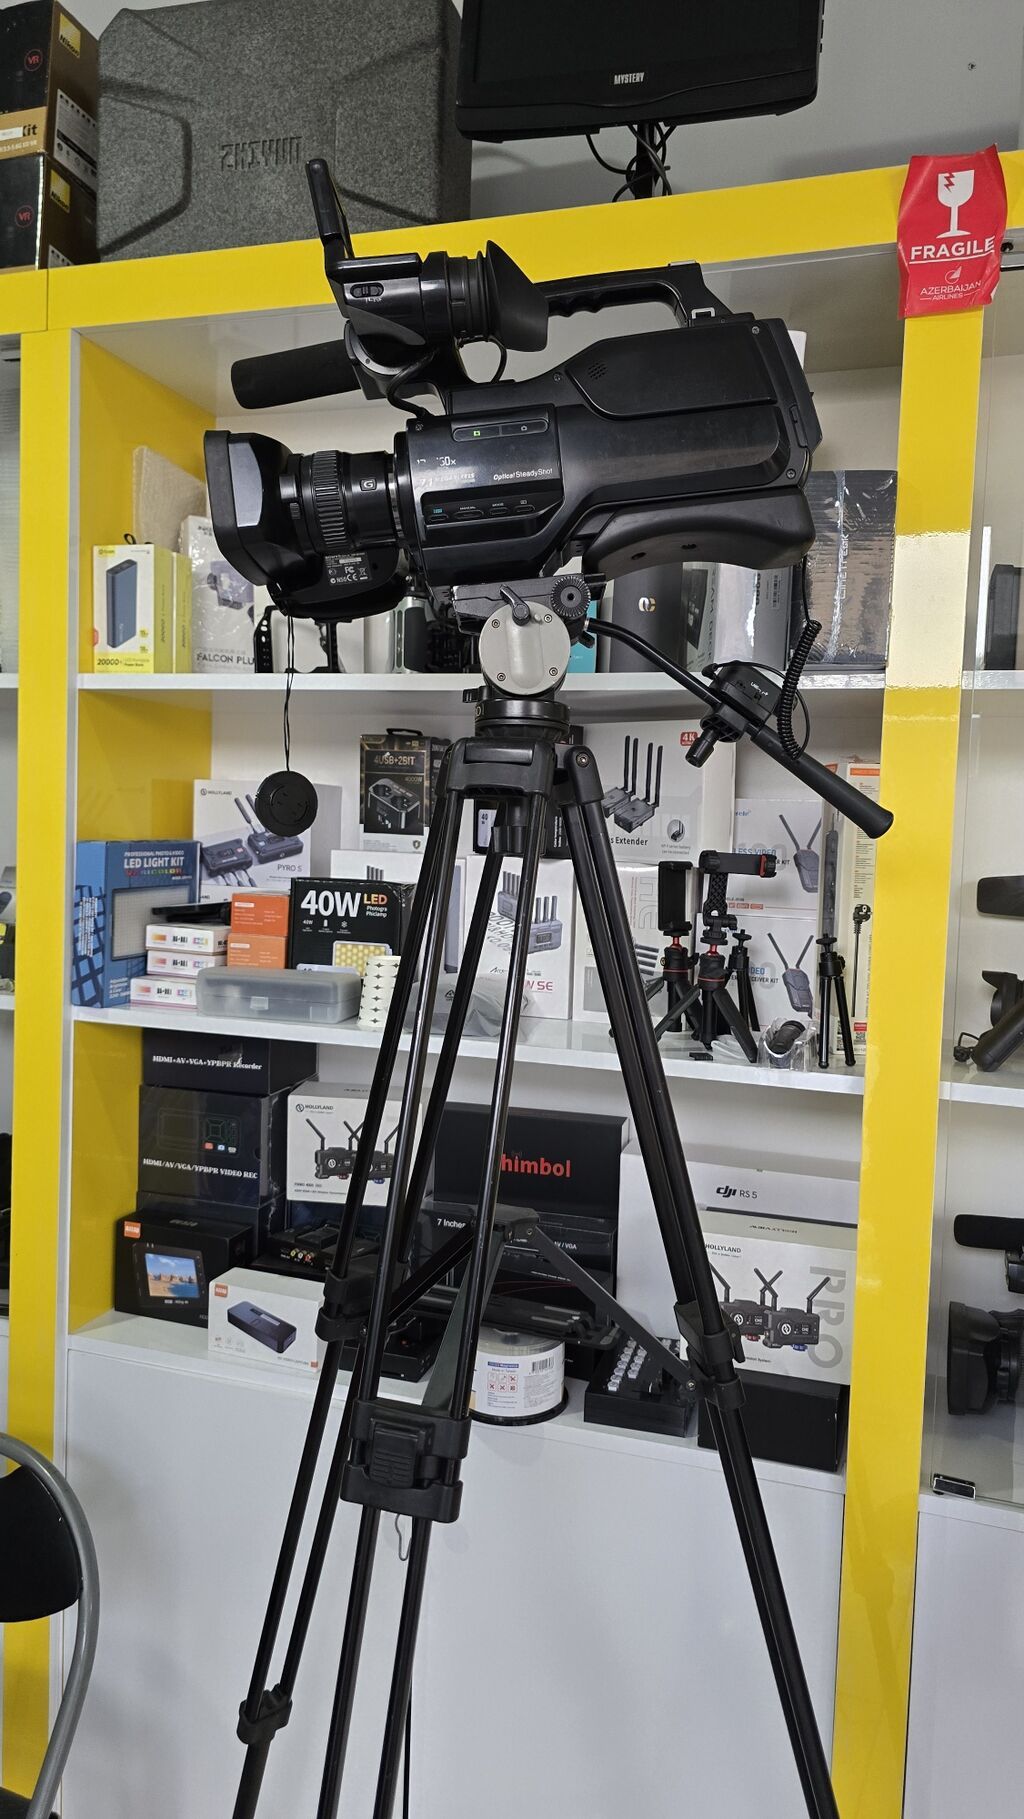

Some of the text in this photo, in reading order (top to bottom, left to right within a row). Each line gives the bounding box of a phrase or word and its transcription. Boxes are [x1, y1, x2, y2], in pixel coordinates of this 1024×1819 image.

[614, 72, 645, 85] MYSTERY
[910, 235, 996, 260] FRAGILE
[920, 280, 982, 297] AZERBAIJAN
[932, 292, 964, 301] AIRLINES
[197, 652, 256, 666] FALCON PLU
[682, 732, 695, 741] 4K
[615, 836, 649, 846] Extender
[124, 856, 185, 869] LED LIGHT KIT
[277, 864, 297, 872] PYRO
[300, 889, 362, 918] 40W
[363, 893, 388, 905] LED
[142, 1157, 259, 1180] HDMI/AV/VGA/YPBPR VIDEO REC
[500, 1153, 572, 1178] himbol
[739, 1189, 751, 1199] RS
[752, 1190, 759, 1200] 5
[437, 1218, 442, 1226] 7
[705, 1243, 742, 1254] HOLLYLAND
